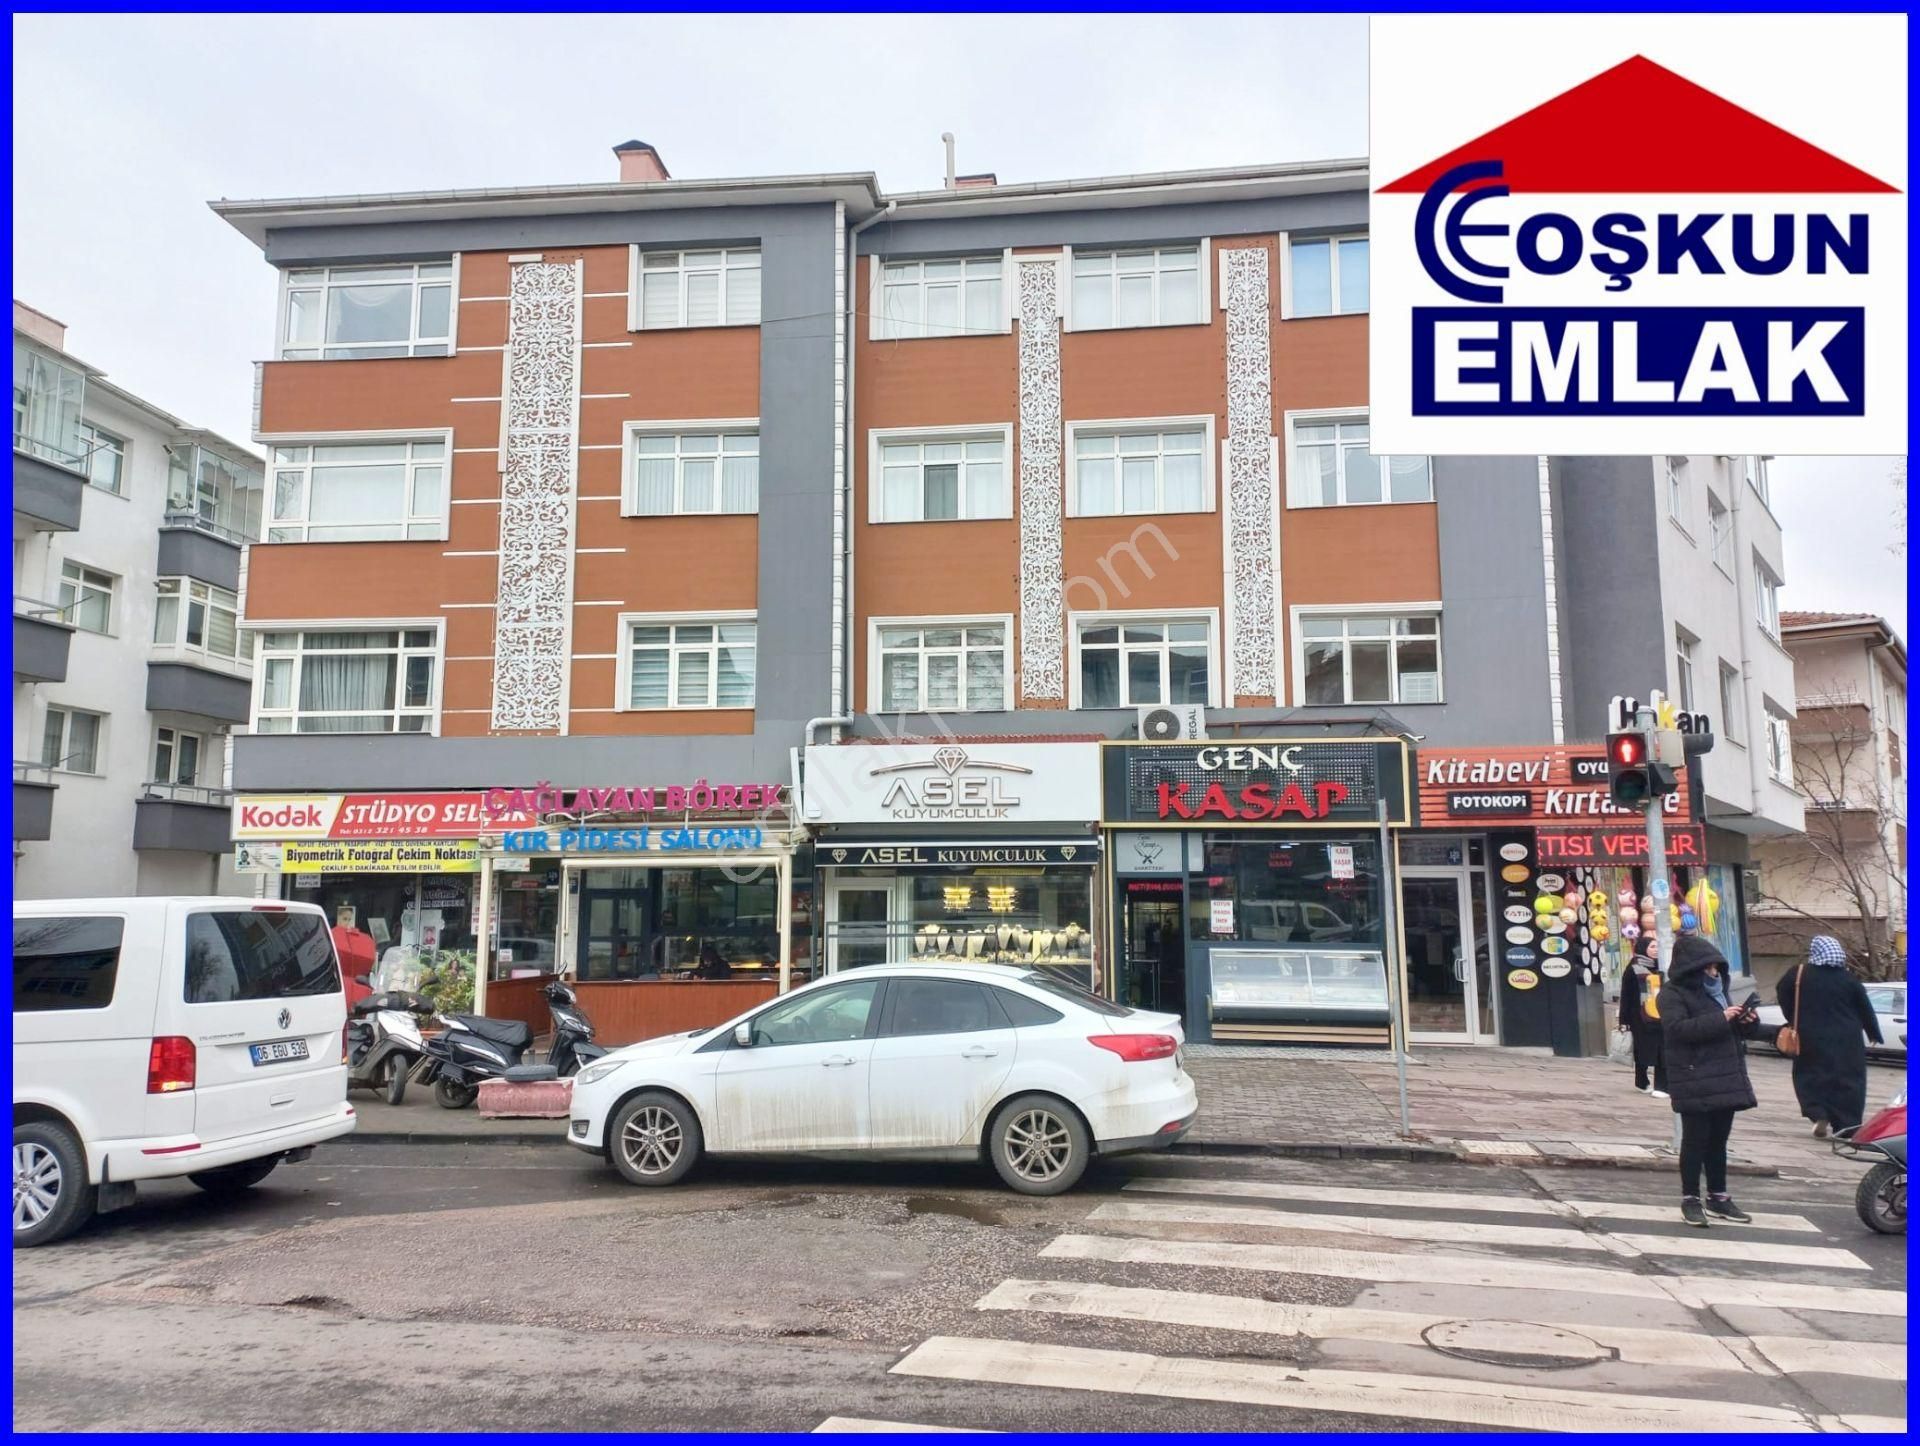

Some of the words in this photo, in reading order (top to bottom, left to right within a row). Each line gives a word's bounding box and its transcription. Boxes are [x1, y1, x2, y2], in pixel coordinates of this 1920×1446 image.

[1189, 708, 1198, 739] REGAL
[1611, 692, 1710, 734] Hkan
[1197, 746, 1305, 776] GENÇ
[1427, 756, 1550, 784] Kitabevi
[1577, 761, 1609, 774] OYU
[486, 780, 654, 820] ÇAĞLAYAN
[666, 779, 783, 812] BÖREK
[881, 777, 1020, 807] ASEL
[1156, 782, 1349, 820] KASAP
[1545, 788, 1680, 815] Kırtae
[241, 804, 322, 828] Kodak
[343, 799, 435, 824] STÜDYO
[892, 808, 1009, 818] KUYUMCULUK
[375, 826, 395, 834] 321
[398, 826, 412, 834] 45
[503, 831, 549, 851] KIR
[560, 826, 648, 851] PİDESİ
[659, 829, 762, 851] SALONU
[286, 849, 345, 863] Biyometrik
[397, 848, 431, 863] Çekim
[860, 848, 928, 863] ASEL
[937, 849, 1047, 862] KUYUMCULUK
[256, 1045, 269, 1060] 06
[273, 1044, 288, 1058] EGU
[291, 1041, 307, 1056] 539
